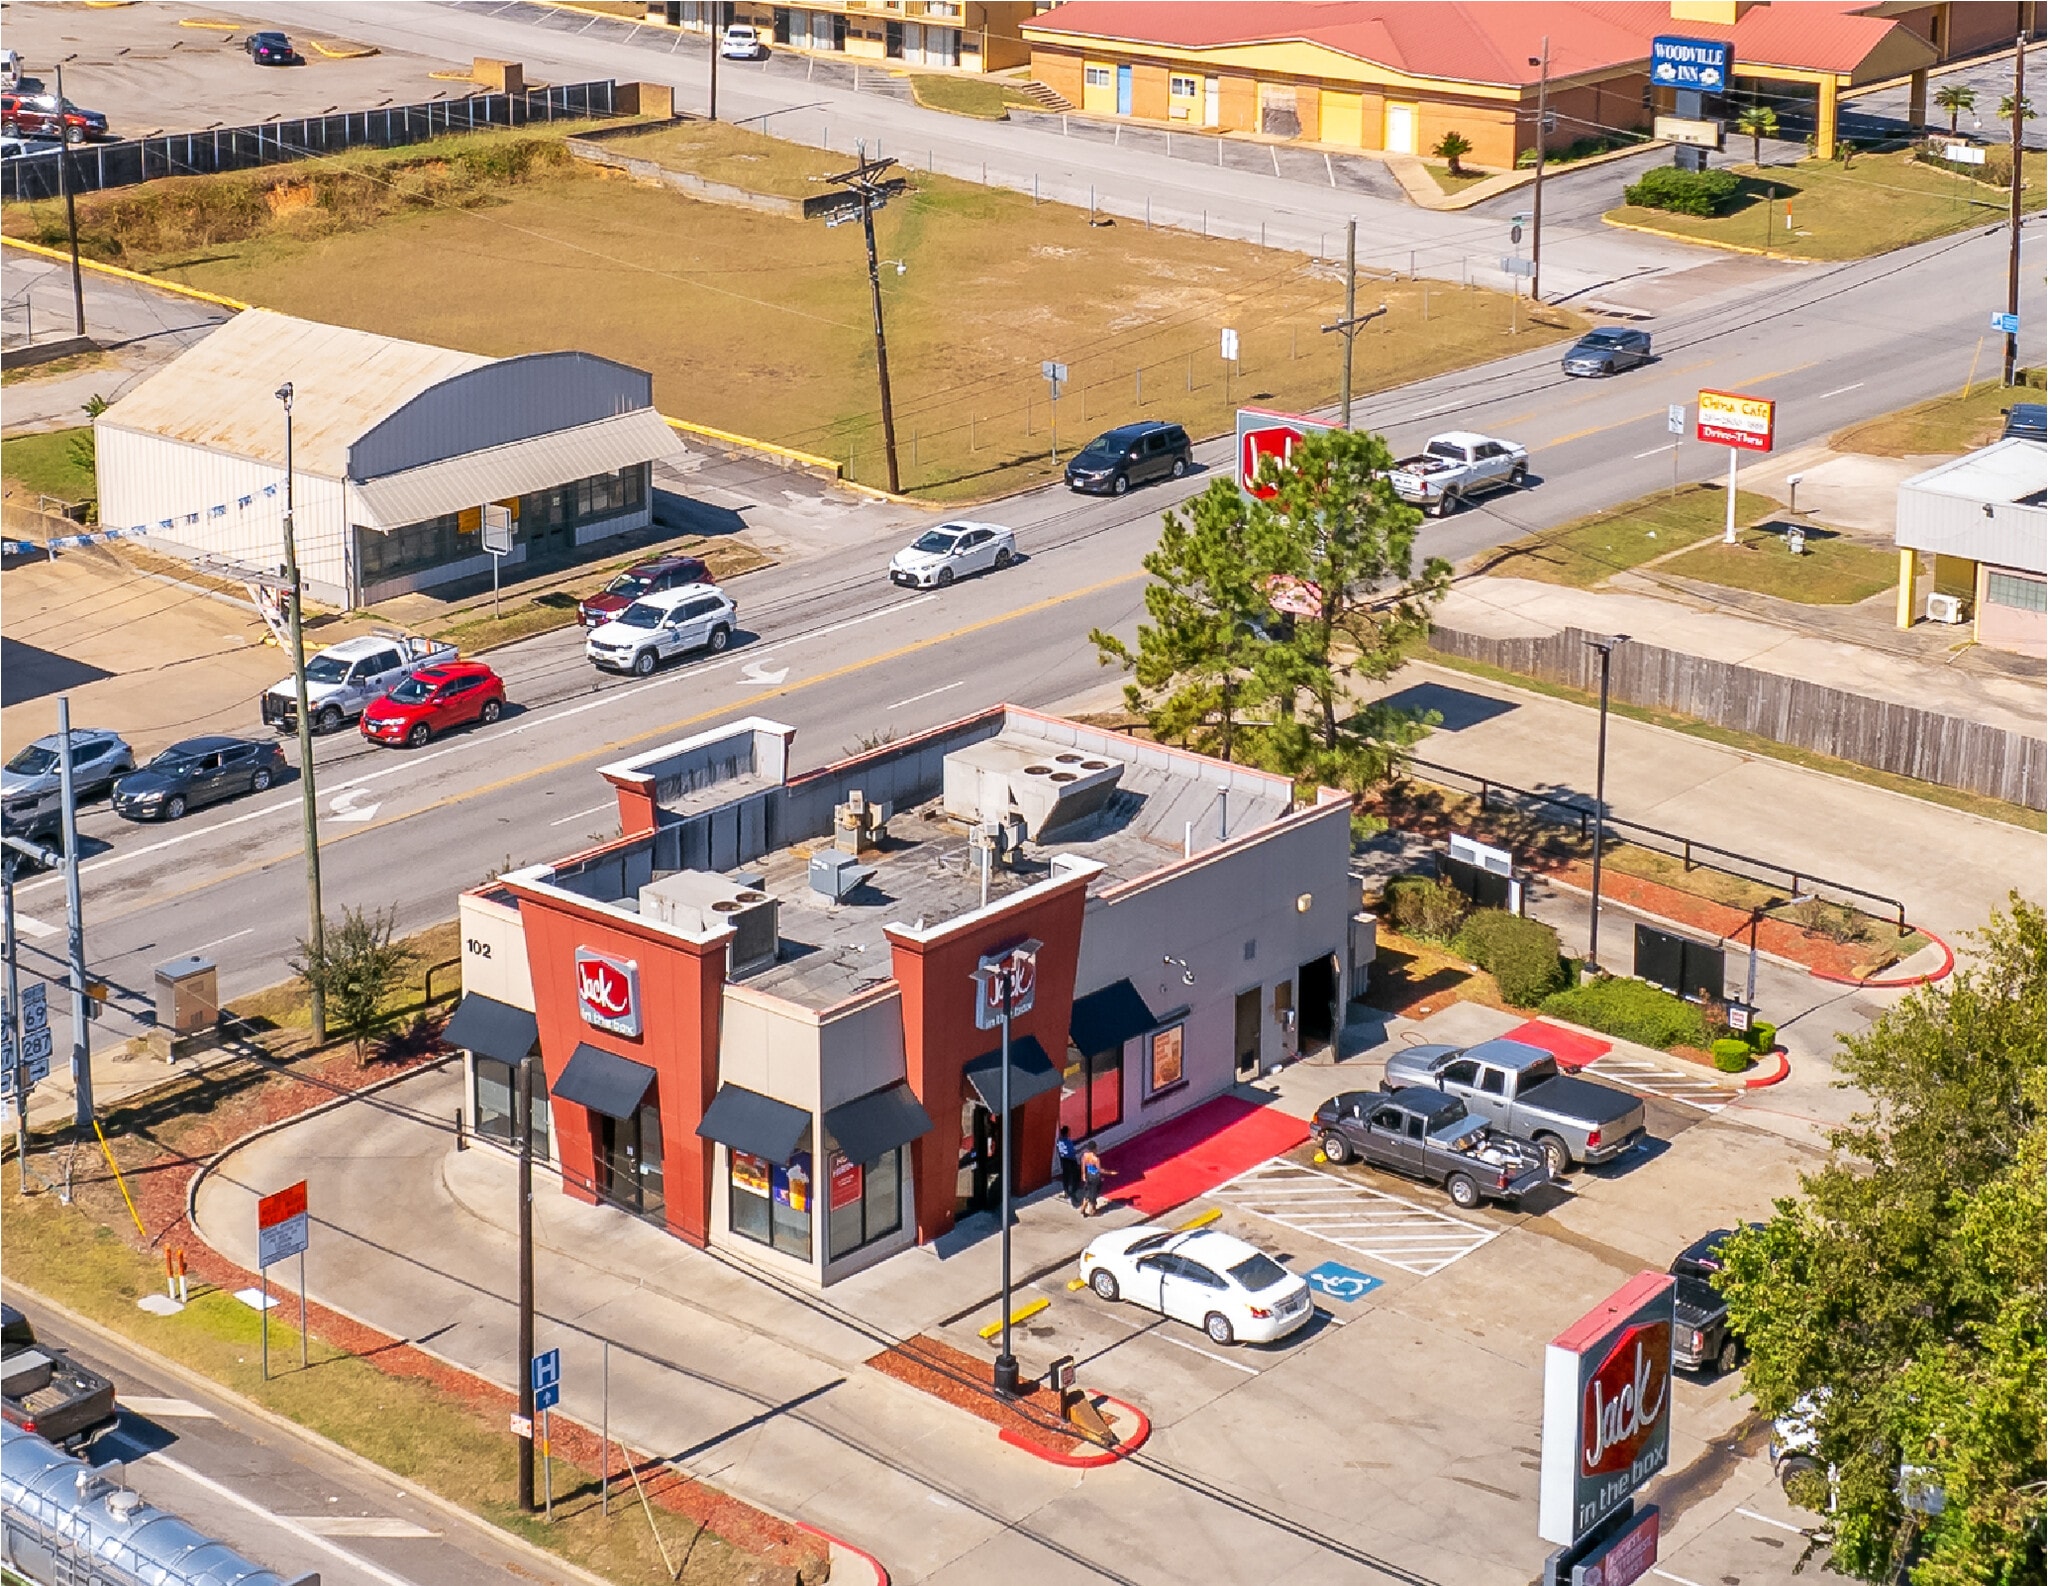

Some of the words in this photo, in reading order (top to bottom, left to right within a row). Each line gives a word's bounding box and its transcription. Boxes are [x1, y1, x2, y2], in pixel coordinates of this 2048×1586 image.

[1655, 43, 1723, 65] WOODVILLE
[1677, 65, 1698, 82] INN
[1743, 403, 1768, 417] Cafe
[468, 939, 491, 960] 102
[580, 963, 627, 1012] Jack
[26, 1006, 44, 1026] 69
[24, 1034, 49, 1057] 287
[537, 1351, 556, 1388] H
[1586, 1342, 1666, 1467] Jack
[1580, 1501, 1597, 1530] in
[1600, 1473, 1630, 1511] the
[1633, 1441, 1664, 1485] box
